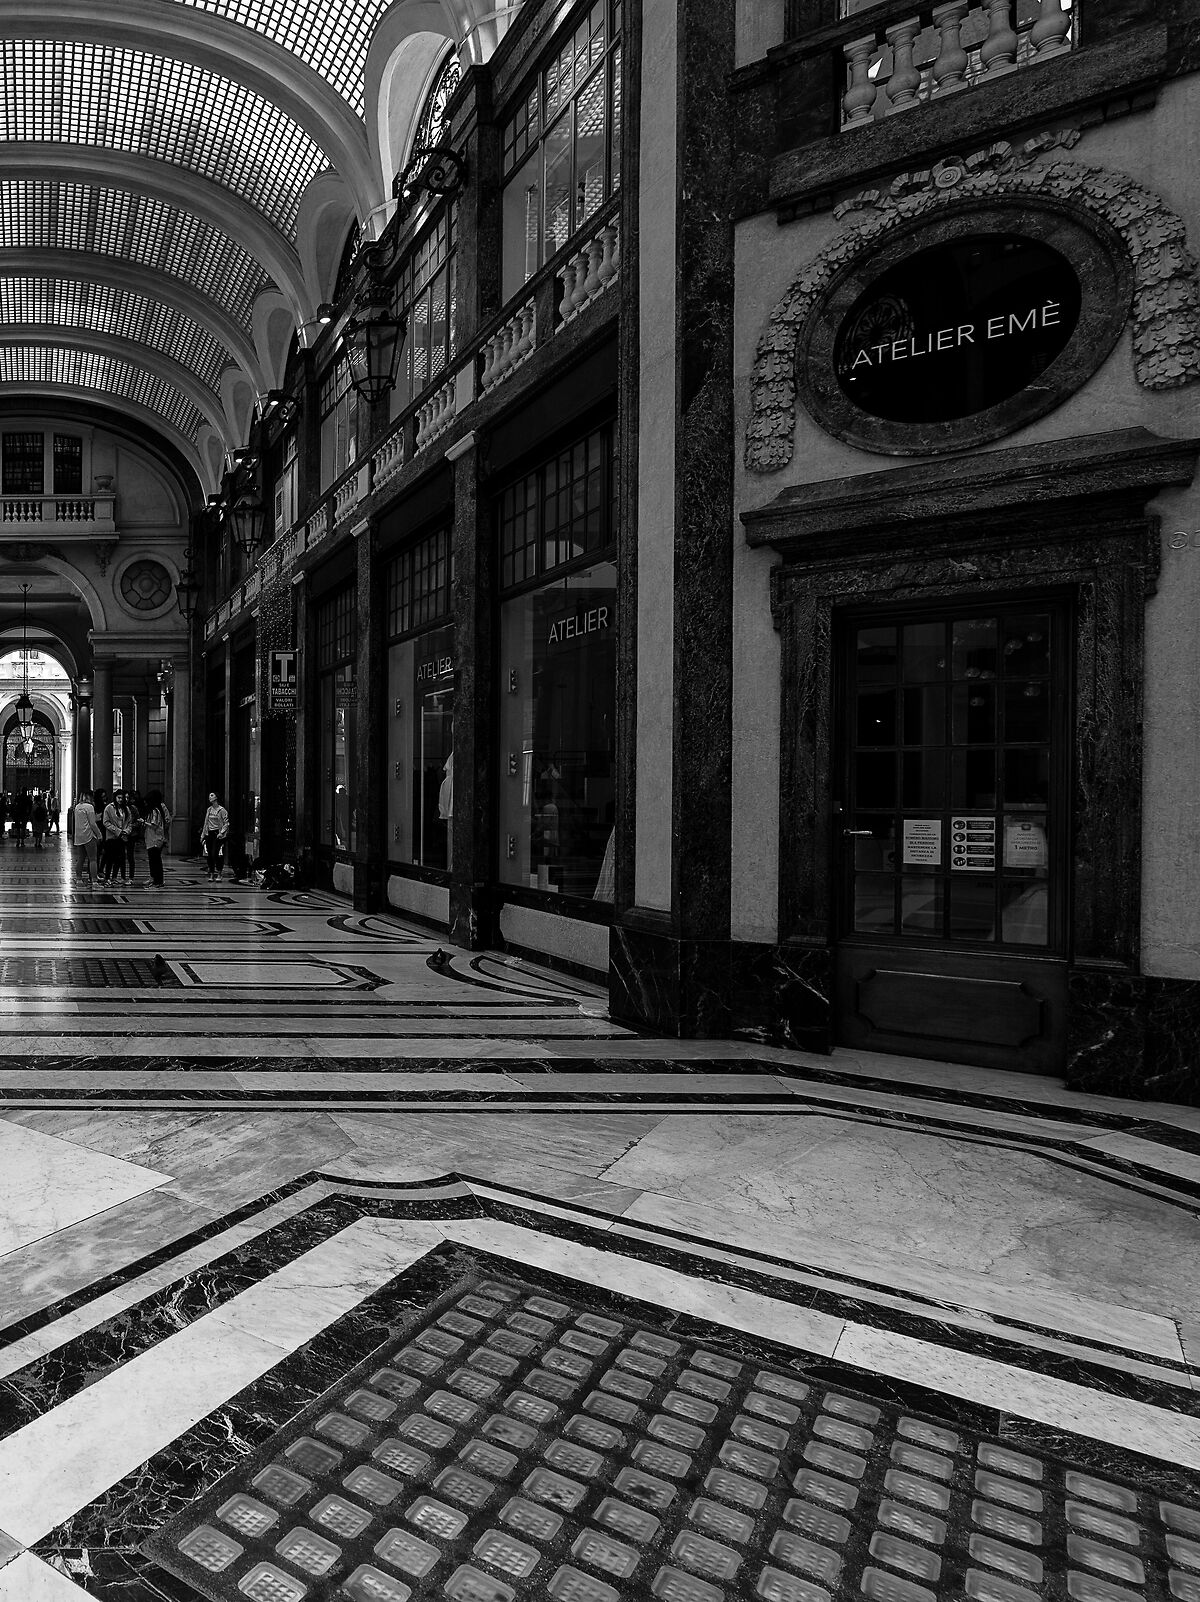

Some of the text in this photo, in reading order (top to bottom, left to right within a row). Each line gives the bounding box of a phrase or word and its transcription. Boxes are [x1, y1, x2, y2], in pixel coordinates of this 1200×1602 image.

[851, 299, 1062, 370] ATELIER EMÈ
[548, 606, 609, 645] ATELIER
[275, 653, 294, 682] T
[416, 655, 453, 682] ATELIER
[271, 687, 297, 696] TABACCHI
